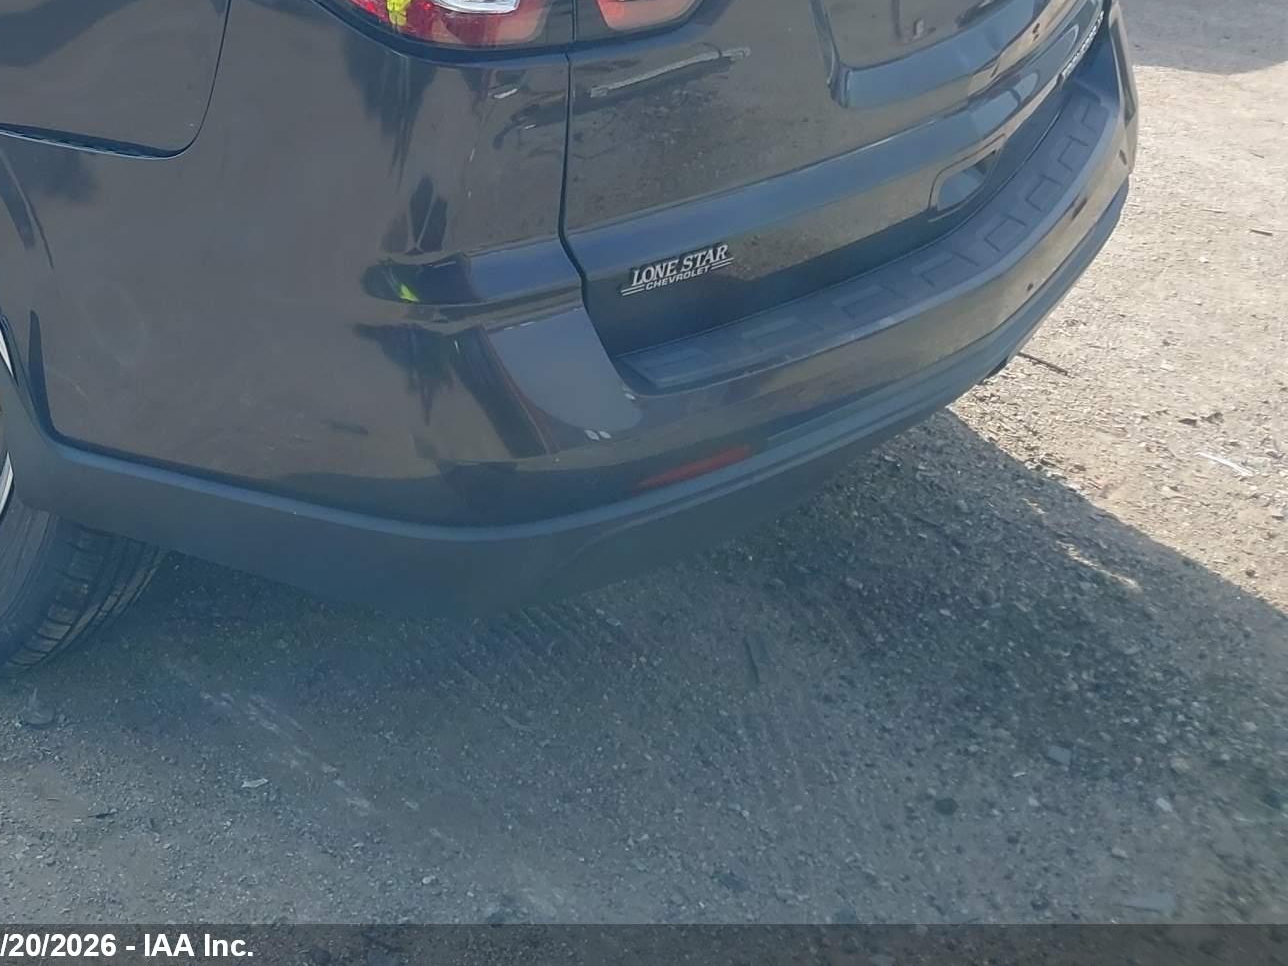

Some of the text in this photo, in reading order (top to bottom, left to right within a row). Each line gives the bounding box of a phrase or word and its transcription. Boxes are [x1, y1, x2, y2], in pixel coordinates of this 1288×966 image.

[632, 244, 728, 286] LONE STAR
[646, 265, 711, 290] CHEVROLET
